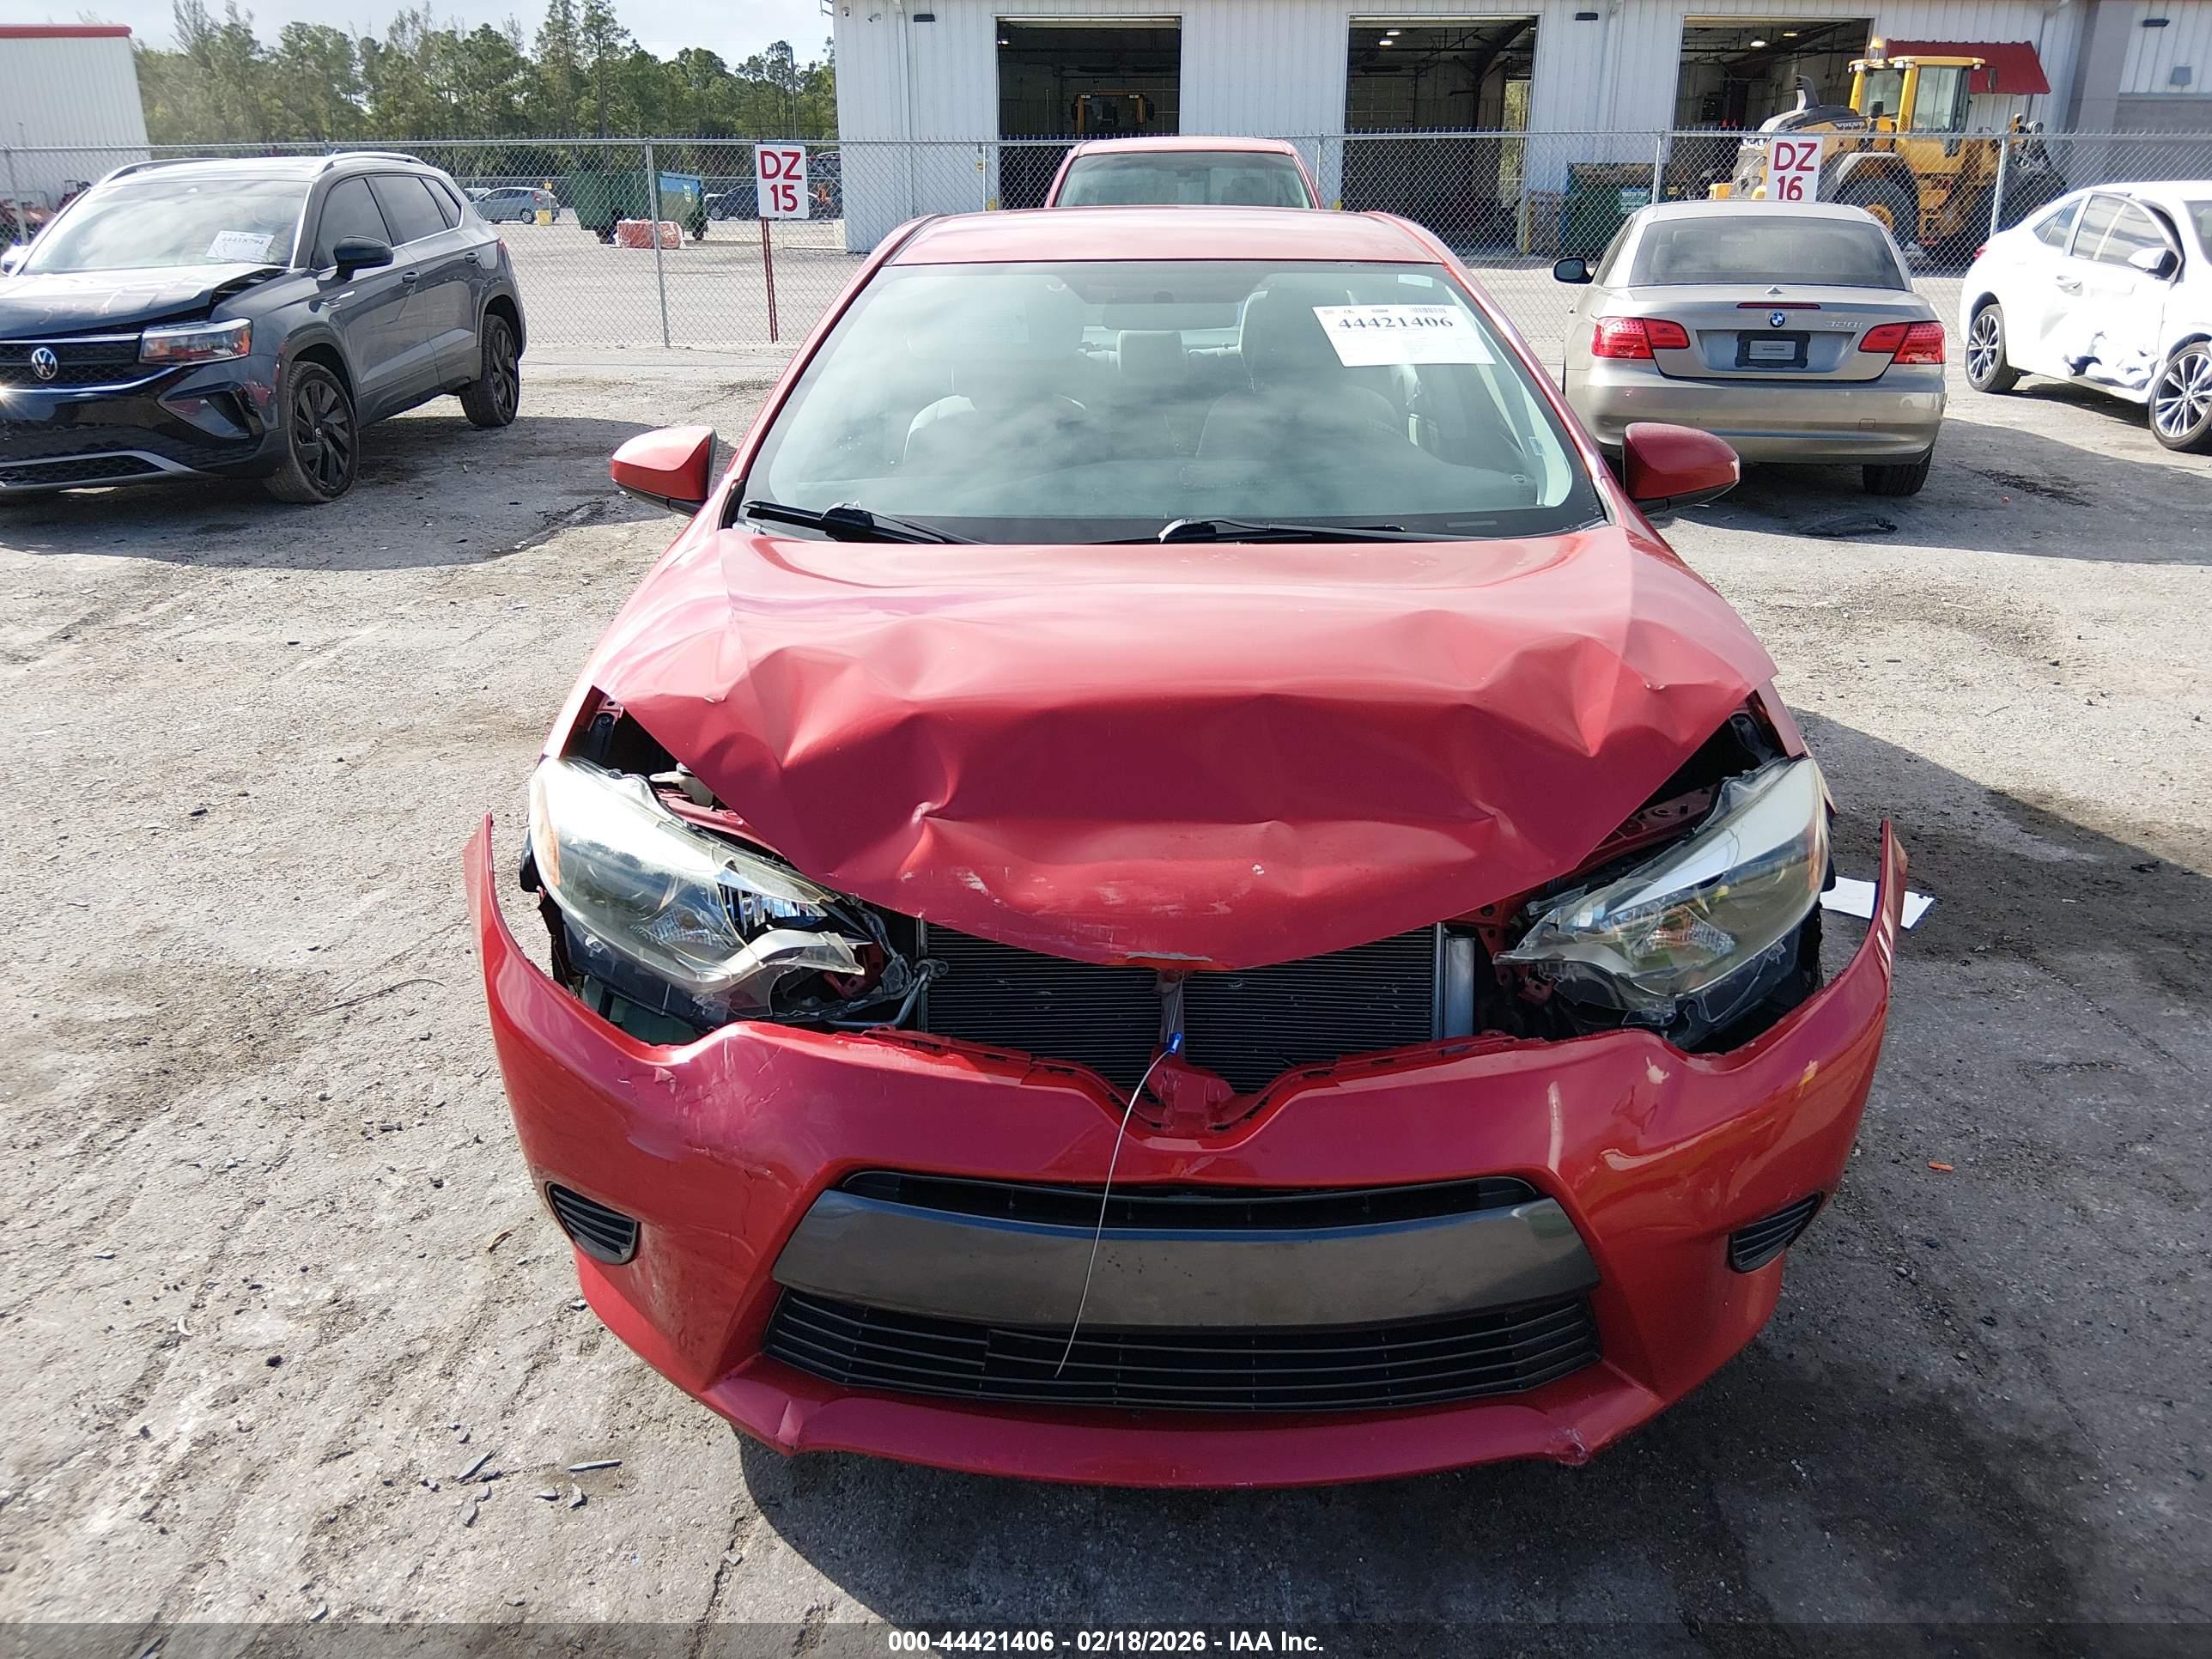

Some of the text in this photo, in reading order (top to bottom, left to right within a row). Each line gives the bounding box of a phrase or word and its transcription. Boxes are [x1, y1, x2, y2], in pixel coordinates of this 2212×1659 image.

[760, 150, 803, 180] DZ
[1773, 142, 1818, 172] DZ
[769, 184, 799, 212] 15
[1777, 175, 1804, 201] 16
[1338, 316, 1454, 329] 44421406
